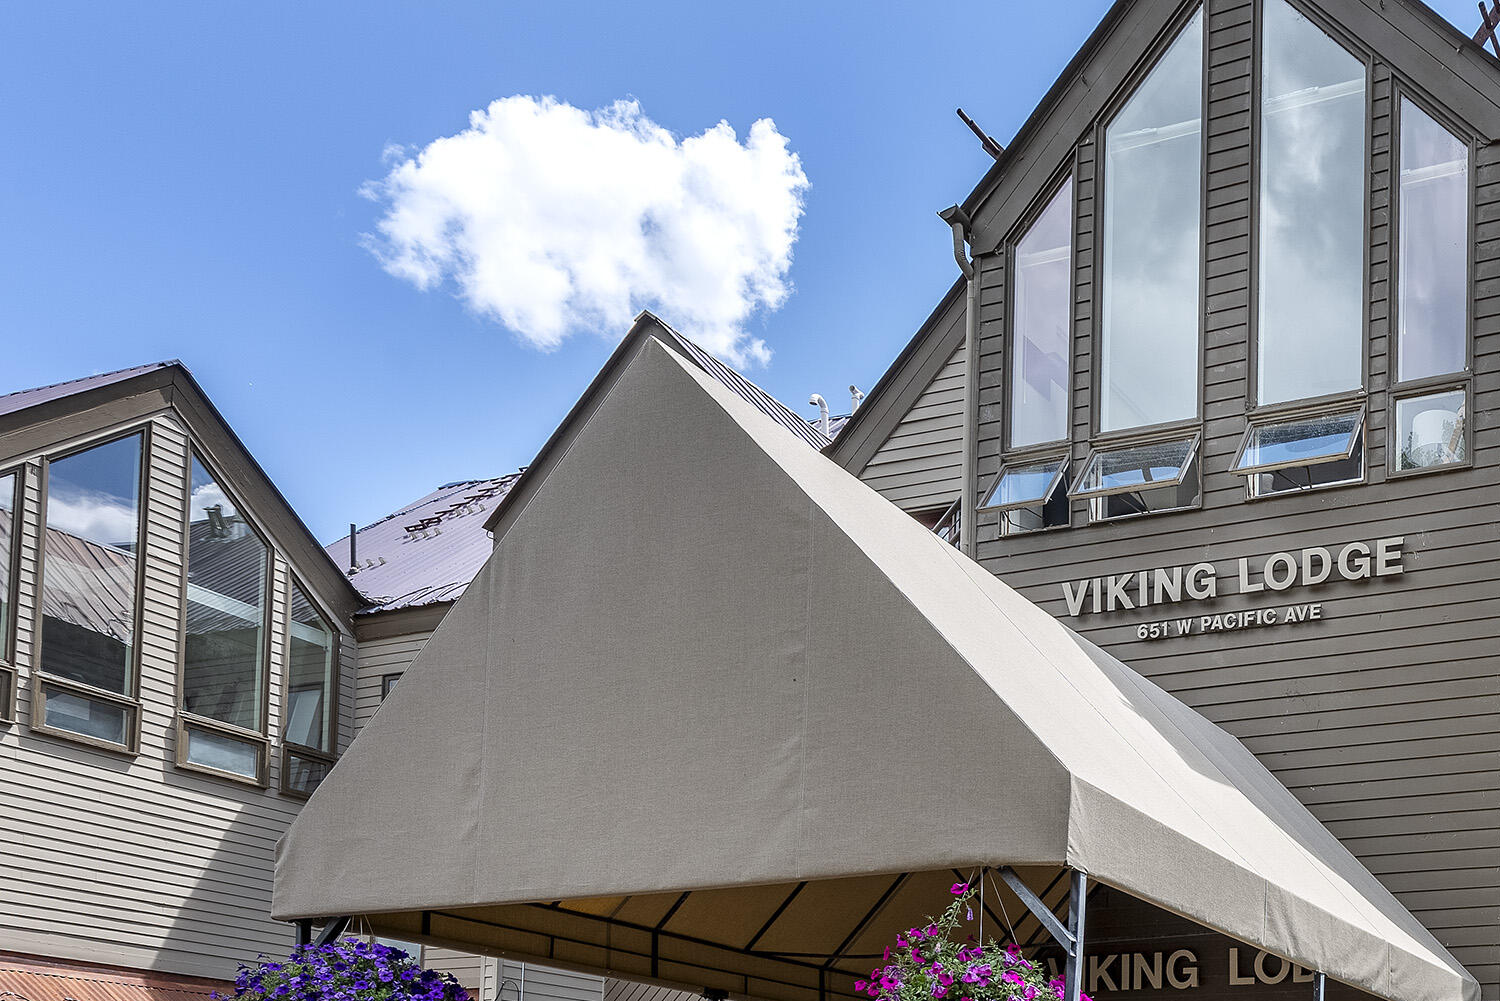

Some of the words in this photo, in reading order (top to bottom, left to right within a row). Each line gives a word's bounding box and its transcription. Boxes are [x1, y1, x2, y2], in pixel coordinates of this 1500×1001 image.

[1061, 563, 1217, 617] VIKING
[1238, 536, 1404, 593] LODGE
[1137, 621, 1168, 639] 651
[1176, 618, 1193, 634] W
[1200, 608, 1277, 632] PACIFIC
[1284, 604, 1322, 623] AVE
[1047, 950, 1200, 992] KING
